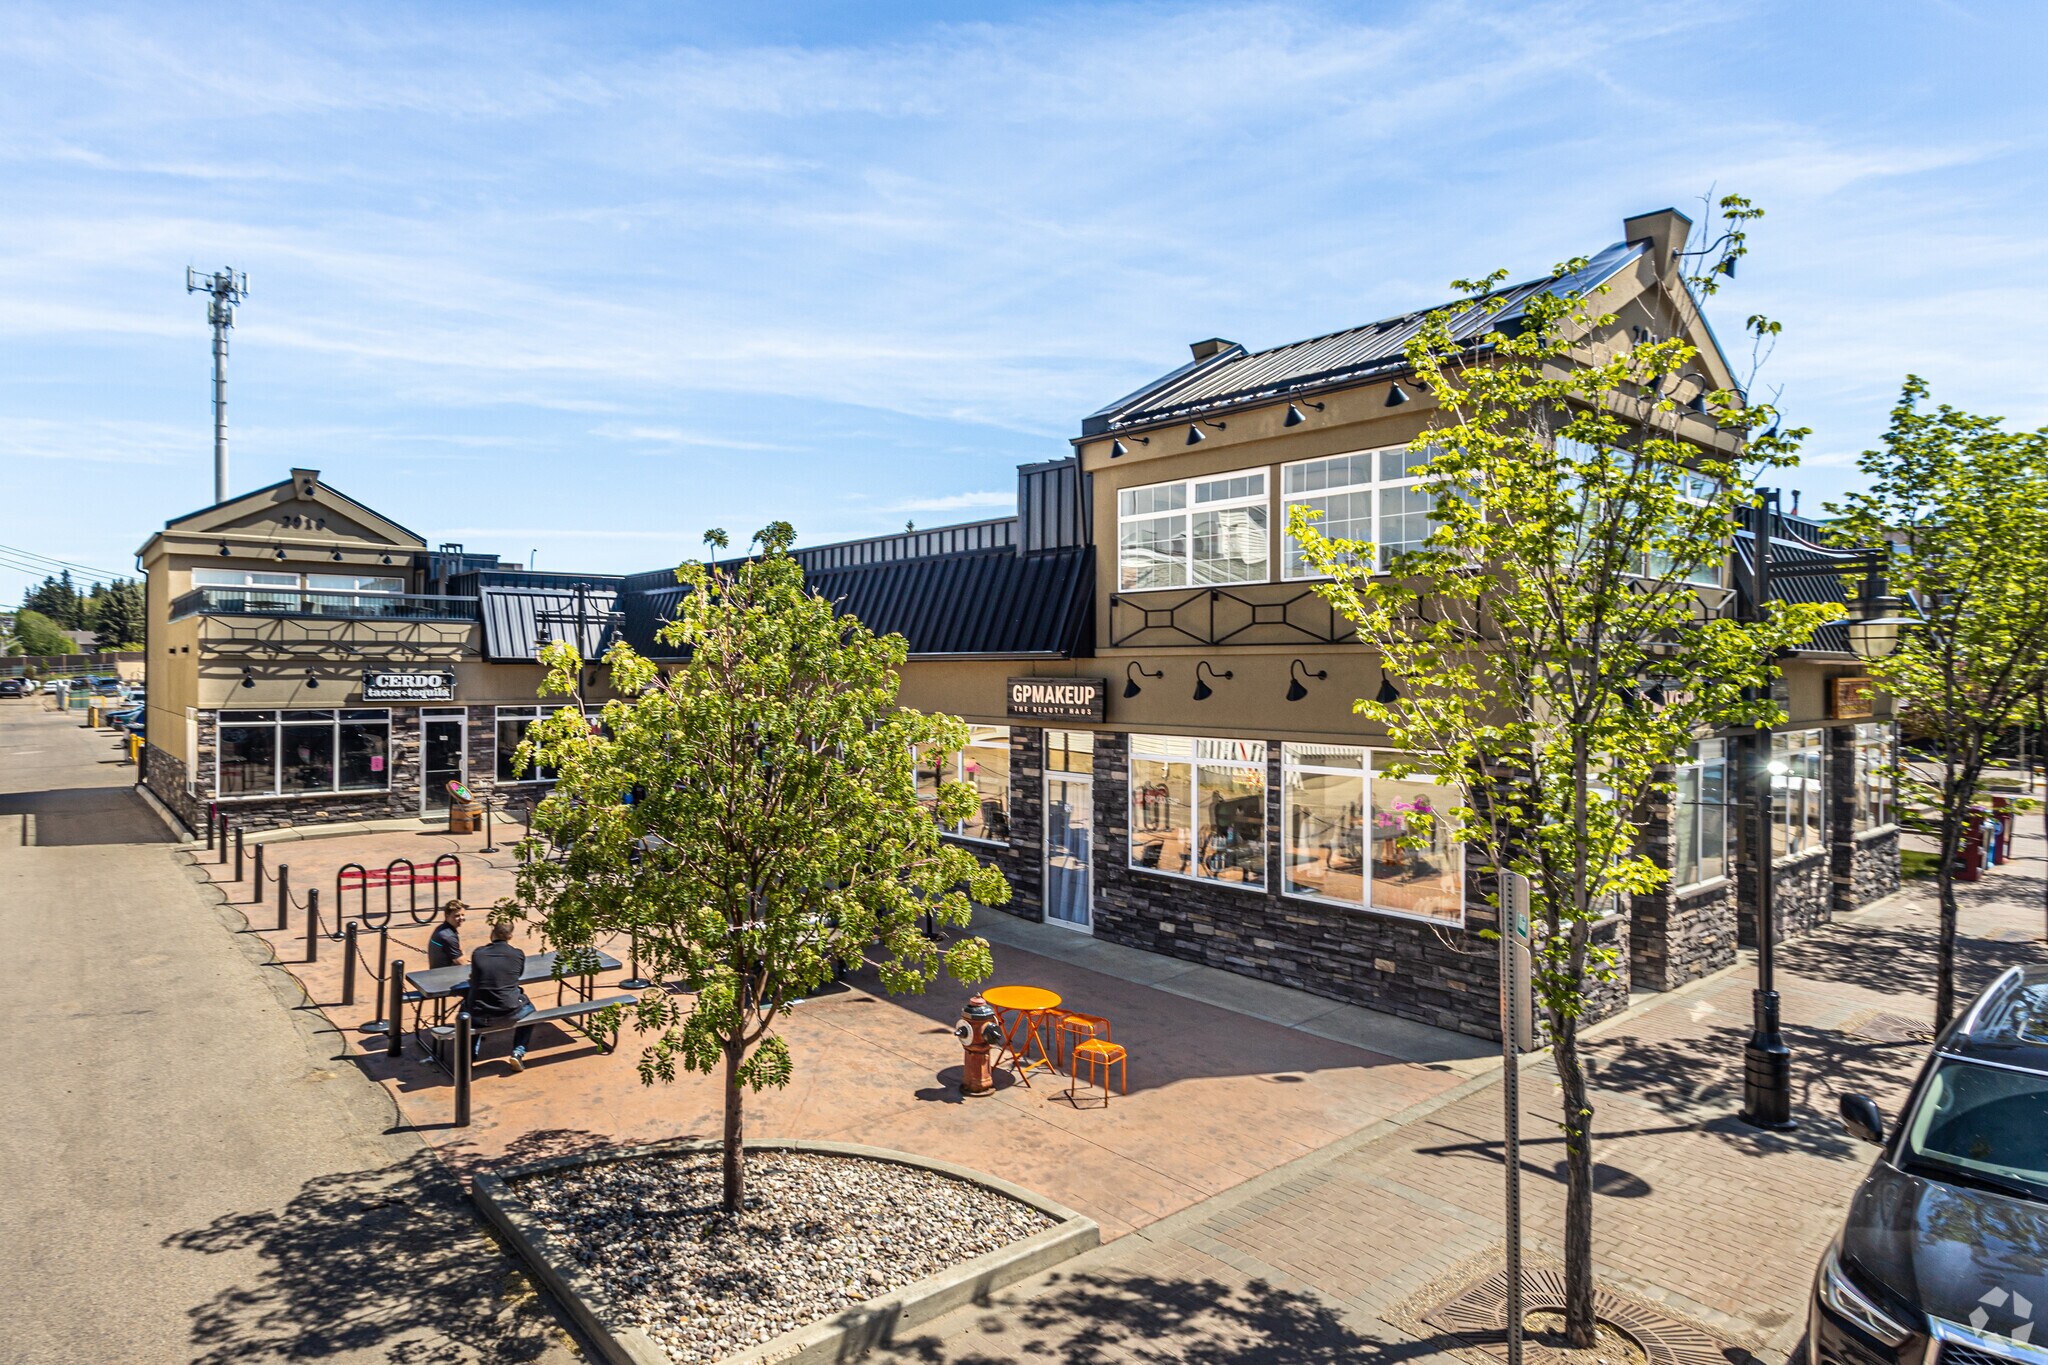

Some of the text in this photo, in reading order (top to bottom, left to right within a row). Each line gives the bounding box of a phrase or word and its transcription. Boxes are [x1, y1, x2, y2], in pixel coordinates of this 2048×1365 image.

[375, 675, 443, 688] CERDO
[1012, 684, 1096, 705] GPMAKEUP
[1014, 705, 1092, 716] THE BEAUTY HAUS
